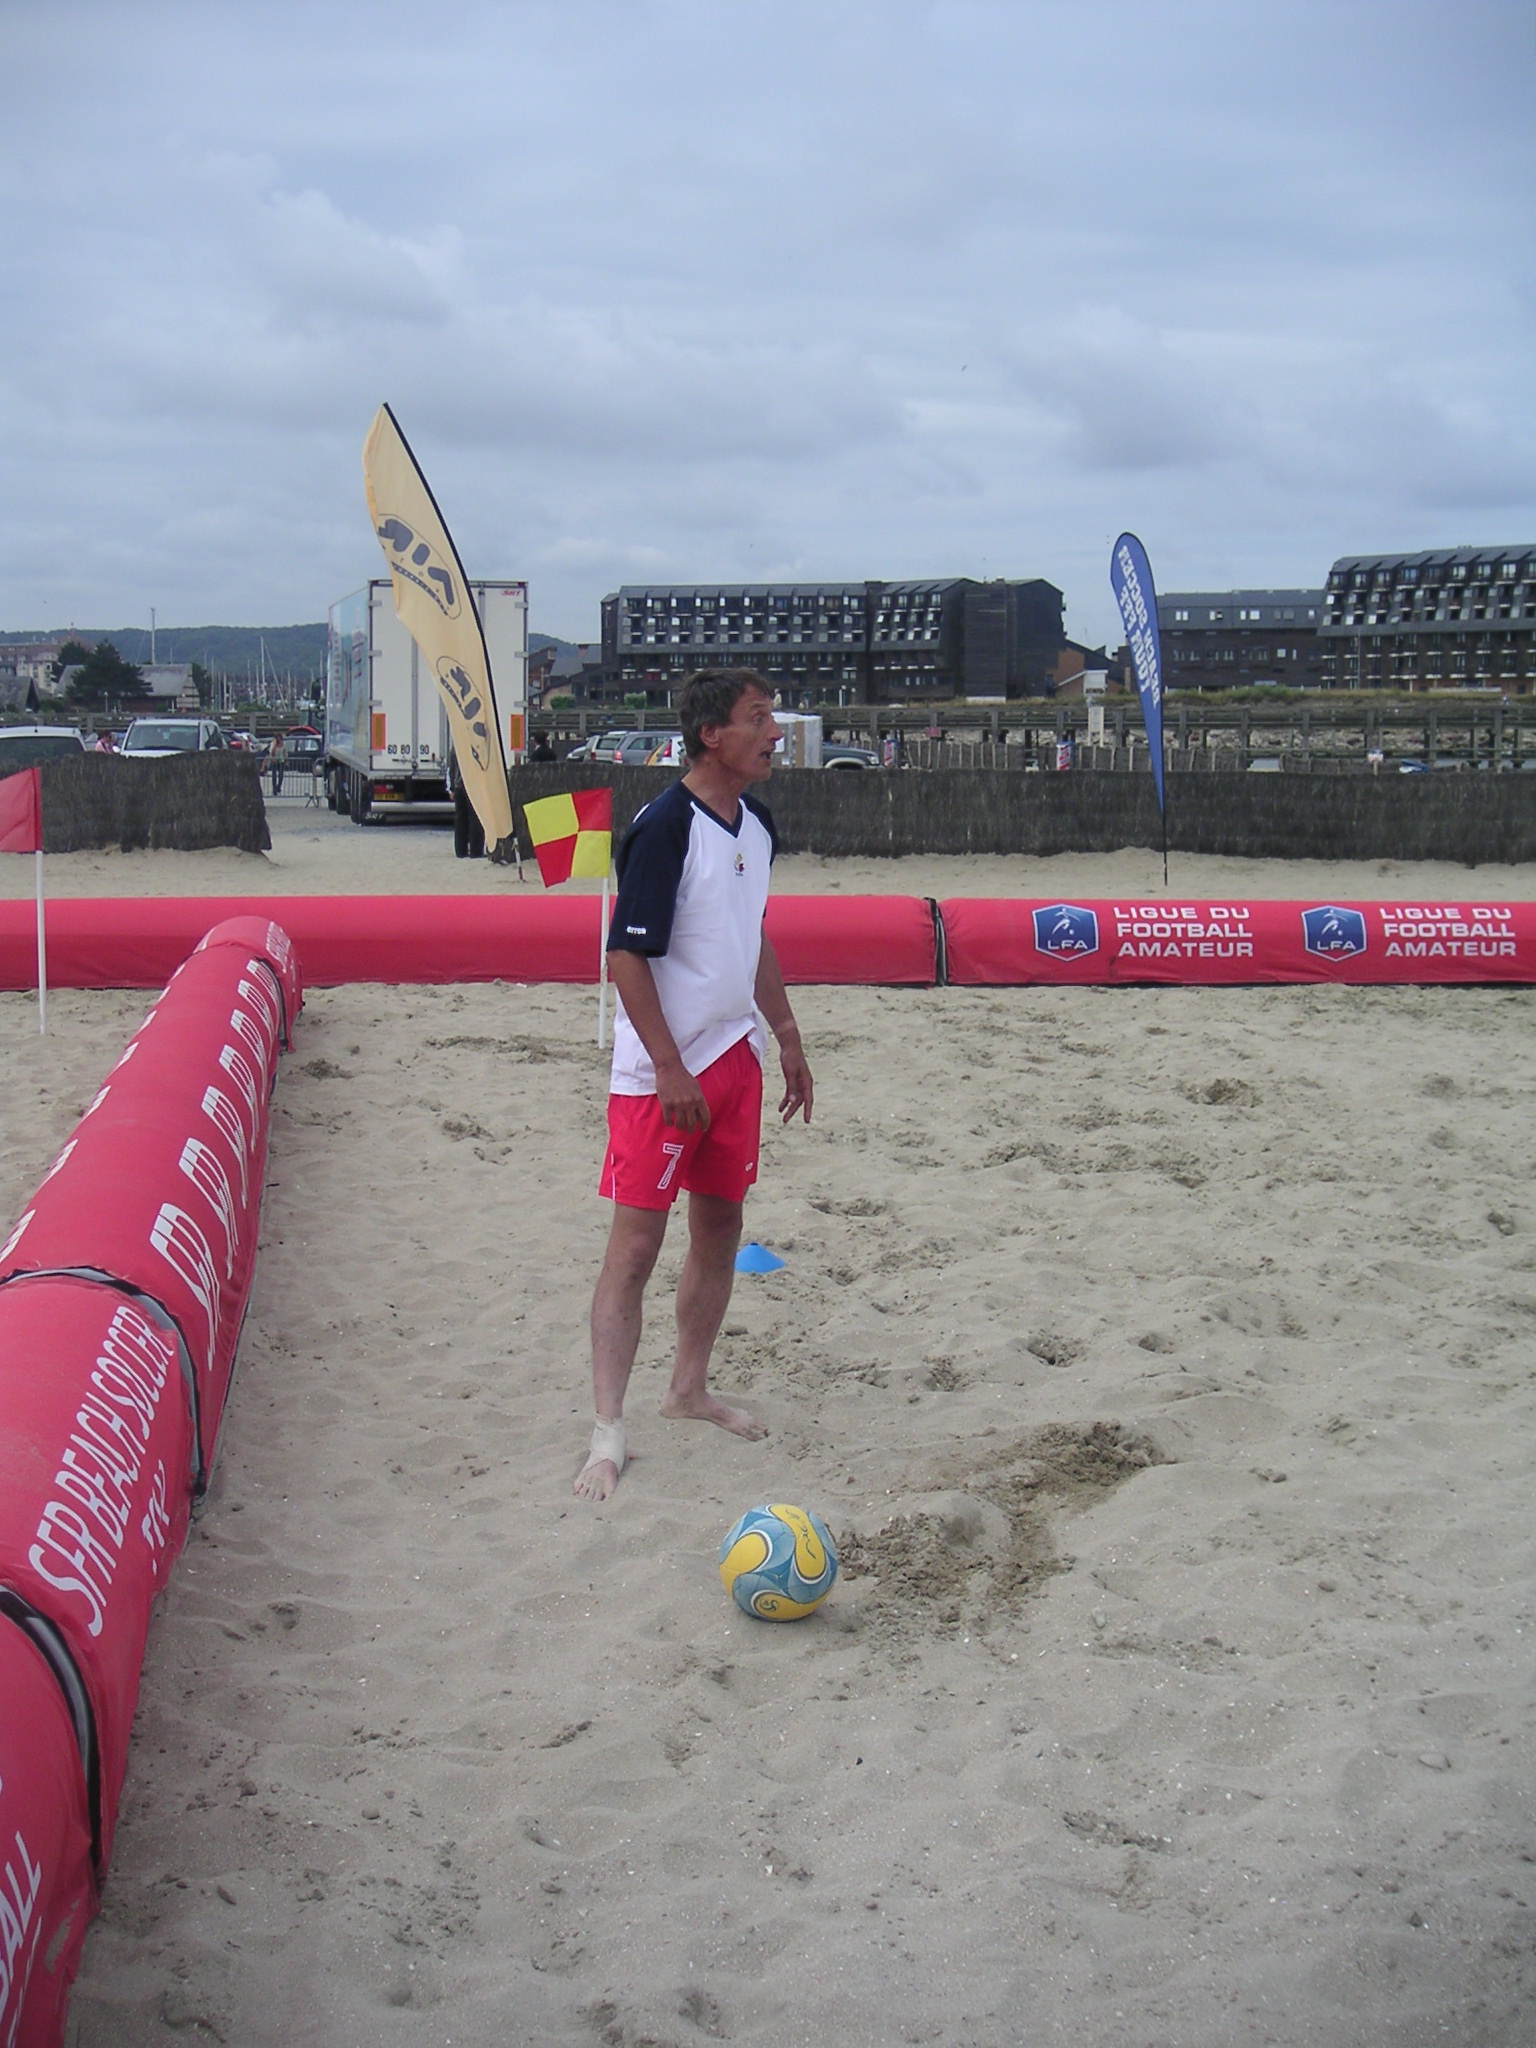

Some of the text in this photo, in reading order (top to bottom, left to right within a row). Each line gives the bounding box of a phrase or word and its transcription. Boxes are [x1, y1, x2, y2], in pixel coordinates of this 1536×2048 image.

[387, 744, 397, 754] 60
[400, 744, 411, 754] 80
[419, 744, 430, 754] 90
[1113, 907, 1250, 919] LIGUE DU
[1379, 908, 1512, 920] LIGUE DU
[1117, 922, 1252, 938] FOOTBALL
[1383, 923, 1515, 937] FOOTBALL
[1047, 939, 1088, 950] LFA
[1118, 942, 1253, 957] AMATEUR
[1317, 940, 1357, 951] LFA
[1385, 942, 1516, 957] AMATEUR
[656, 1142, 685, 1190] 7
[28, 1305, 175, 1637] SFR BEACH SOCCER
